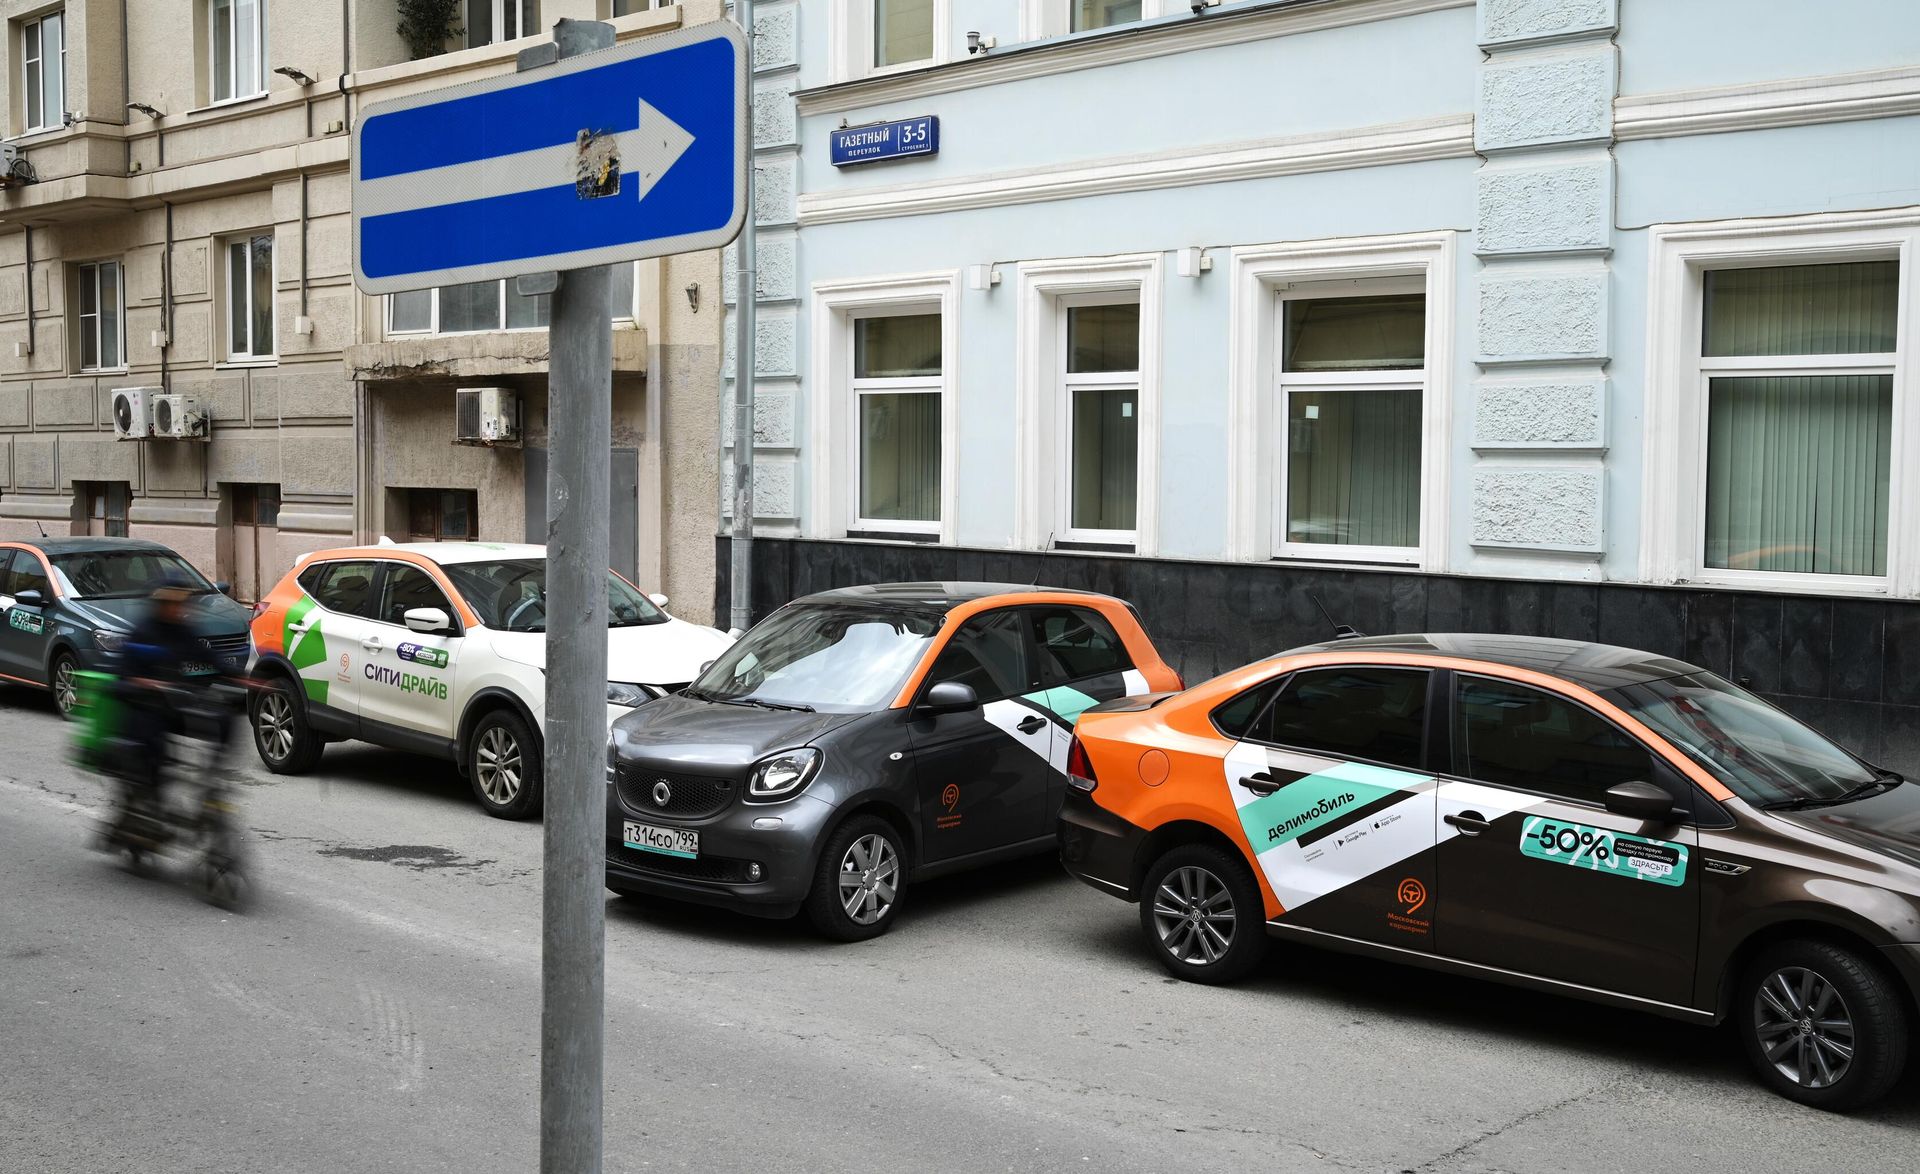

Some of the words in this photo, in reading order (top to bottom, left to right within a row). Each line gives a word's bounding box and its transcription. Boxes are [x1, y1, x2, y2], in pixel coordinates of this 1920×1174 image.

[840, 127, 889, 148] ГАЗЕТНЫЙ
[903, 122, 926, 143] 3-5
[848, 146, 881, 157] ПЕРЕУЛОК
[364, 663, 448, 700] СИТИДРАЙВ
[1268, 792, 1355, 842] делимобиль
[1381, 819, 1390, 827] App
[1390, 815, 1401, 823] Store
[675, 831, 694, 847] 799
[1345, 834, 1359, 843] Google
[1527, 824, 1609, 860] -50%
[1617, 847, 1637, 855] поездку
[1645, 853, 1673, 862] промокоду
[1643, 846, 1662, 854] первую
[1631, 859, 1669, 872] ЗДРАСЬТЕ
[1388, 912, 1429, 927] Московский
